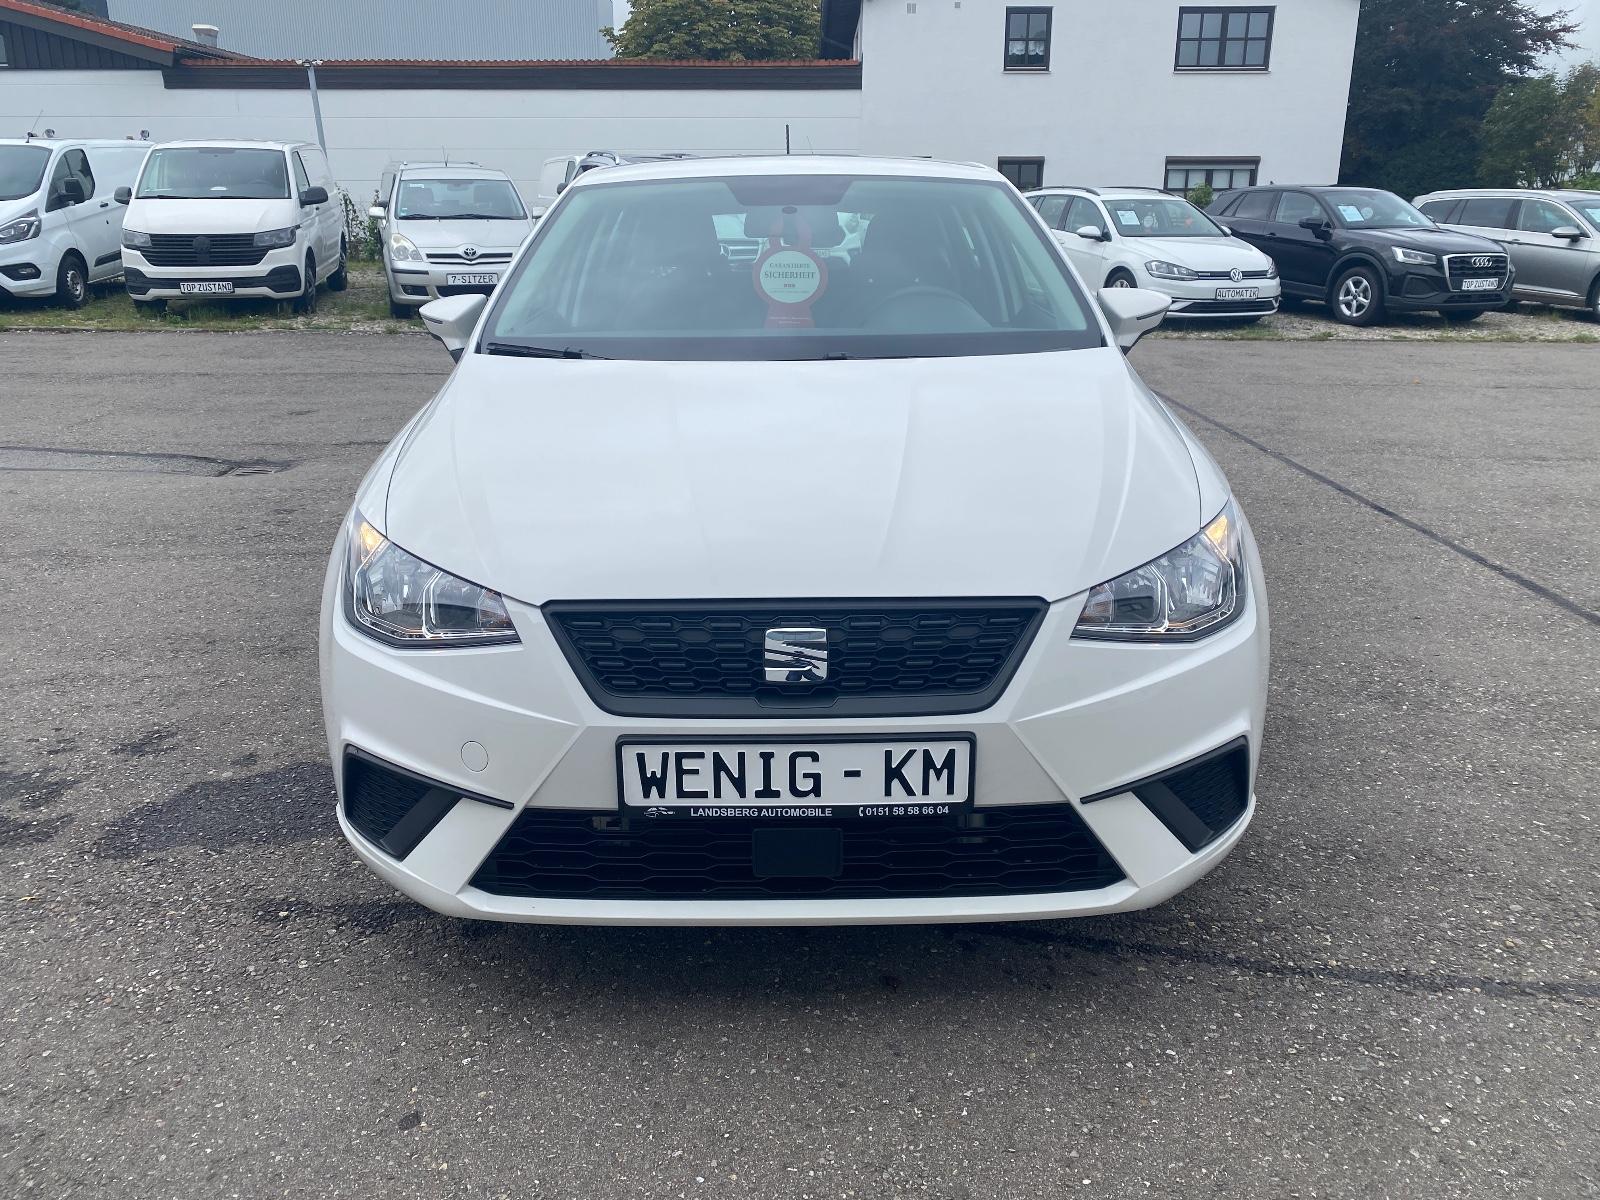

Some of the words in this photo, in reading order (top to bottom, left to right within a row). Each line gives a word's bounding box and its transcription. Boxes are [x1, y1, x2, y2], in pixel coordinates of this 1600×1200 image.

[451, 274, 494, 284] 7-SITZER
[764, 270, 816, 279] SICHERHEIT
[180, 283, 196, 292] TOP
[197, 282, 232, 292] ZUSTAND
[1463, 280, 1474, 289] TOP
[1216, 289, 1258, 298] AUTOMATIK
[635, 750, 822, 799] WENIG
[884, 748, 956, 797] KM
[690, 807, 758, 817] LANDSBERG
[760, 807, 833, 817] AUTOMOBILE
[865, 807, 889, 816] 0151
[892, 806, 905, 816] 58
[907, 806, 920, 815] 58
[922, 806, 934, 815] 66
[936, 805, 950, 815] 04
